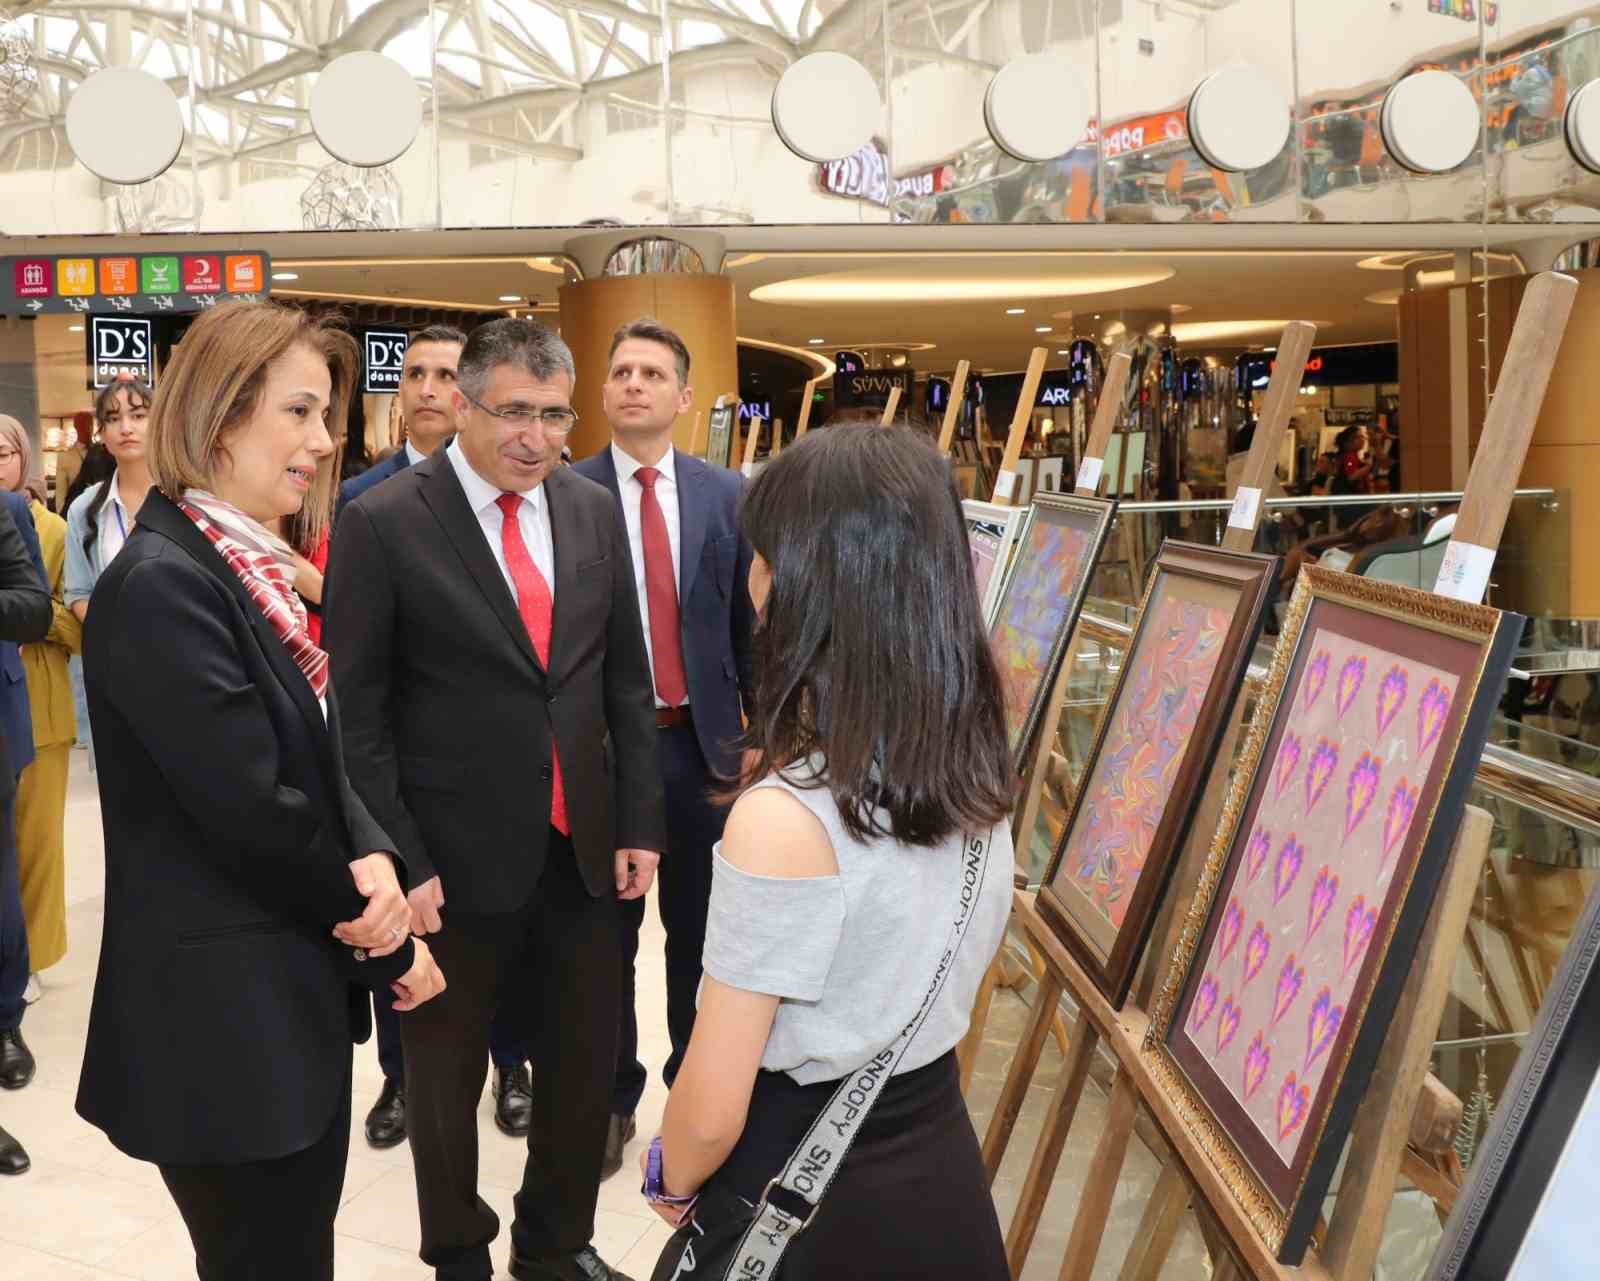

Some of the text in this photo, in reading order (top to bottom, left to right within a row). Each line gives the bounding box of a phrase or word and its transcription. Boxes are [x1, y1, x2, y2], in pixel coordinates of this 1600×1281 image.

[98, 328, 147, 358] D'S
[369, 340, 405, 366] D'S
[370, 370, 400, 382] dama
[954, 837, 984, 934] SNOOPY
[829, 1050, 894, 1137] SNOOPY
